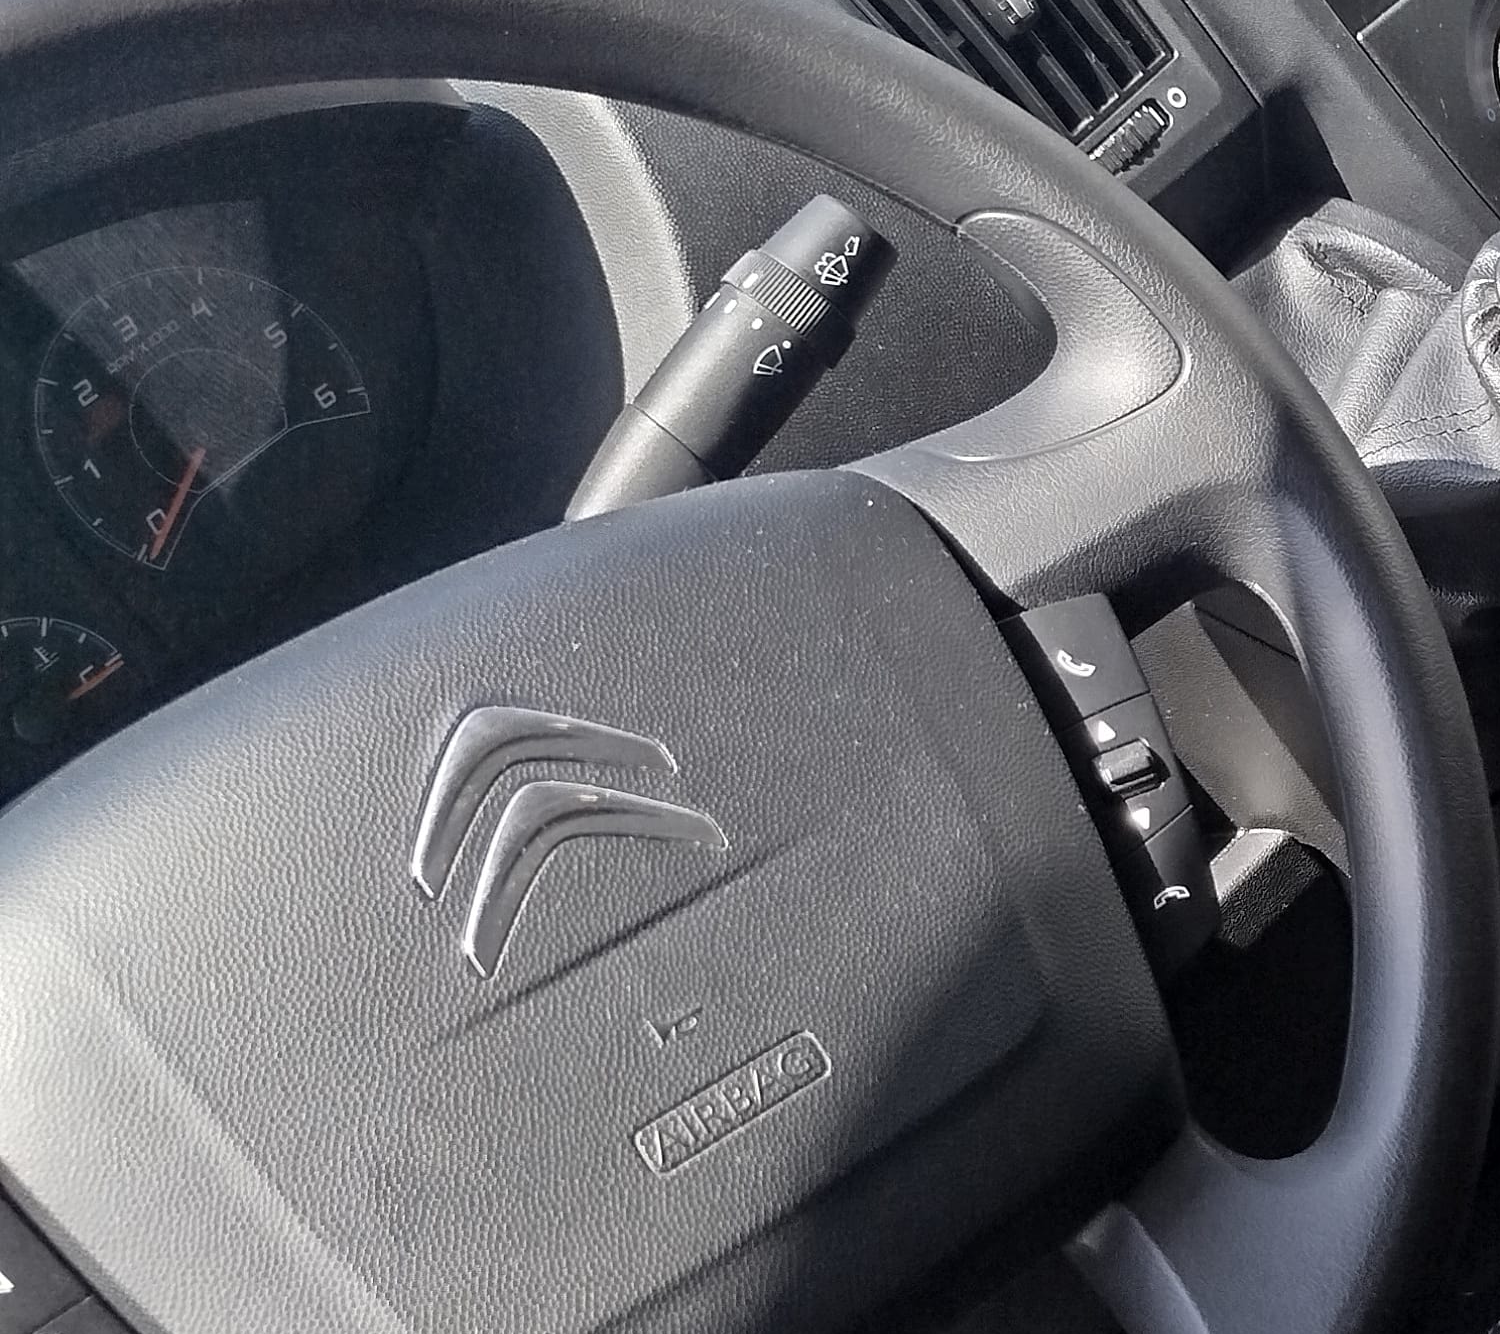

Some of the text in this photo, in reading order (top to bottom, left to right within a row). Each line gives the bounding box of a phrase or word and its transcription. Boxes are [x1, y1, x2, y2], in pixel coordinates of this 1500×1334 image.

[190, 297, 213, 323] 4
[113, 314, 138, 343] 3
[263, 321, 288, 349] 5
[72, 378, 99, 407] 2
[313, 382, 337, 409] 6
[84, 458, 101, 479] 1
[653, 1045, 815, 1171] AIRBAG
